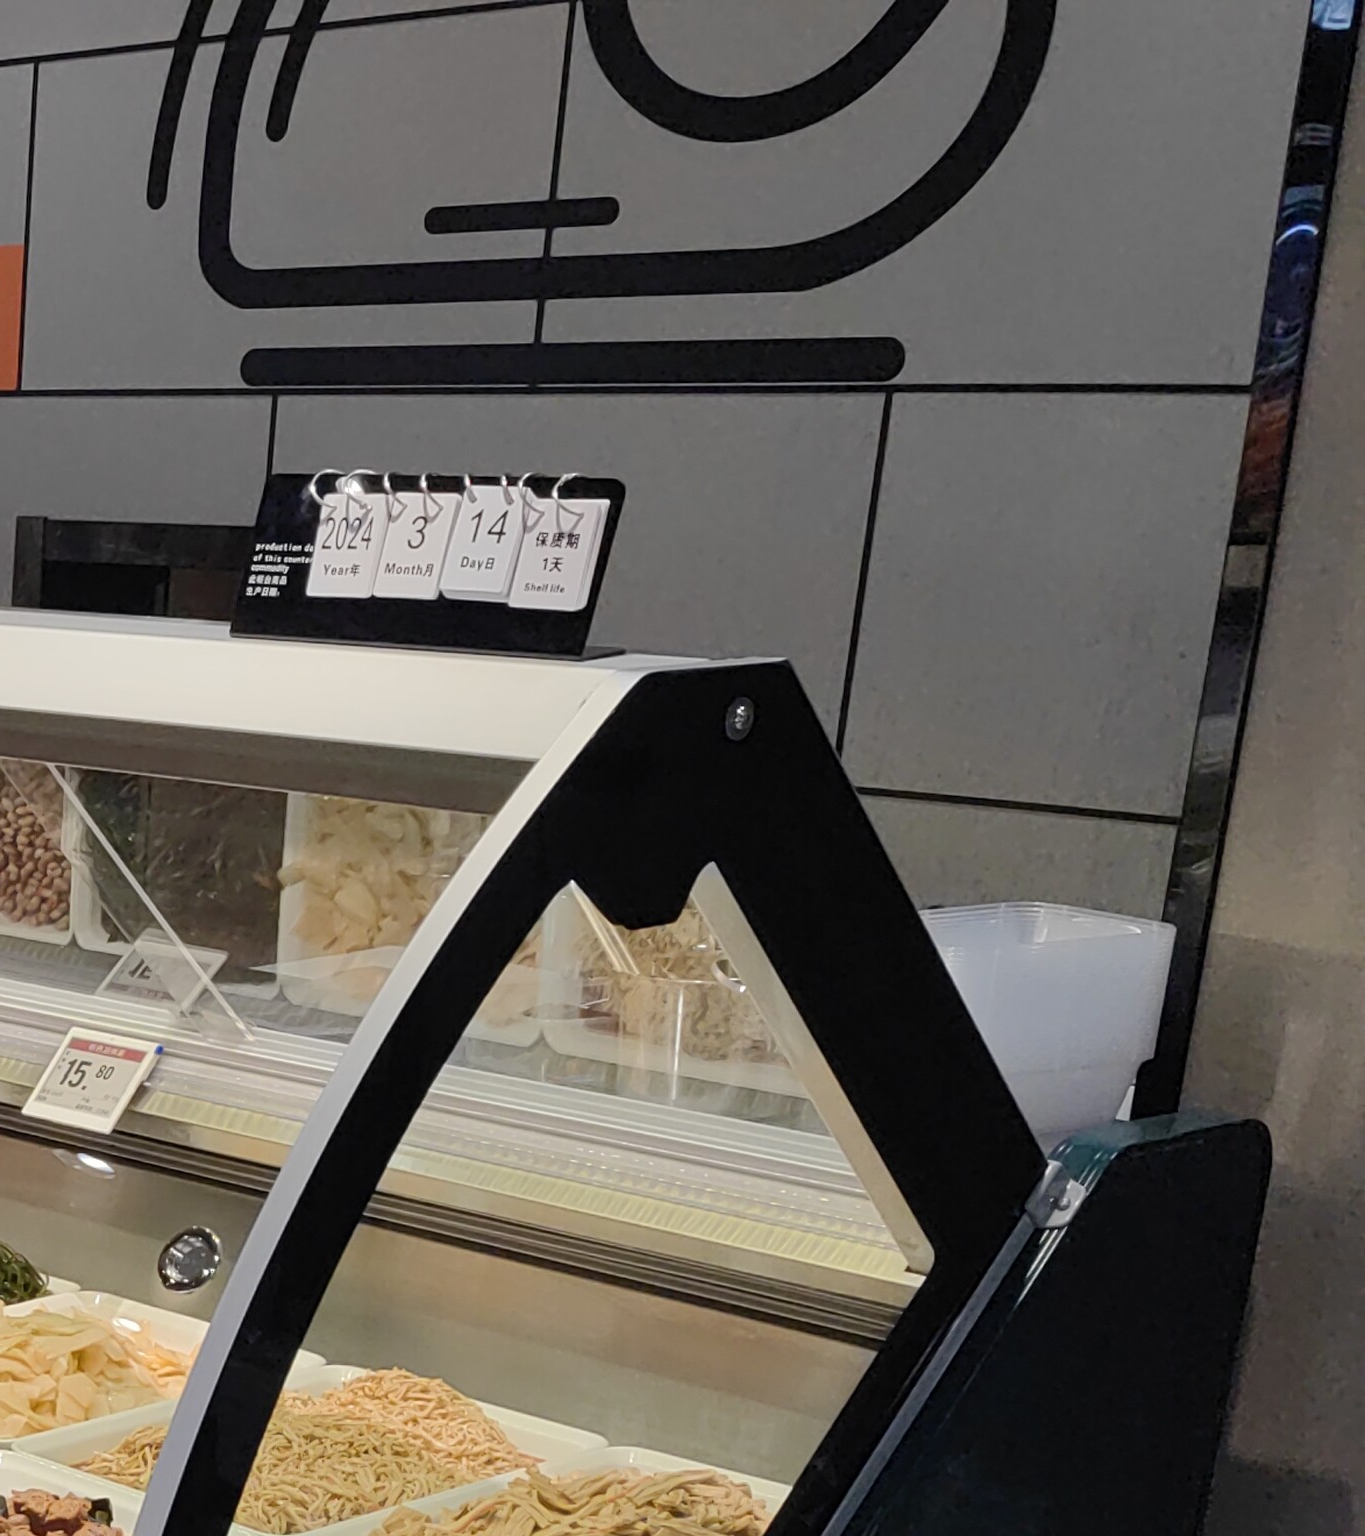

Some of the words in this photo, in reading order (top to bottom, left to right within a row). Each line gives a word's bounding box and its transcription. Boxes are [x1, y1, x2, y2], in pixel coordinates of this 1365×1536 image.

[321, 516, 374, 551] 2024
[407, 515, 429, 550] 3
[469, 508, 510, 545] 14
[534, 531, 581, 550] 保质期
[541, 557, 564, 574] 1天
[524, 582, 549, 592] Shelf
[550, 583, 565, 593] life
